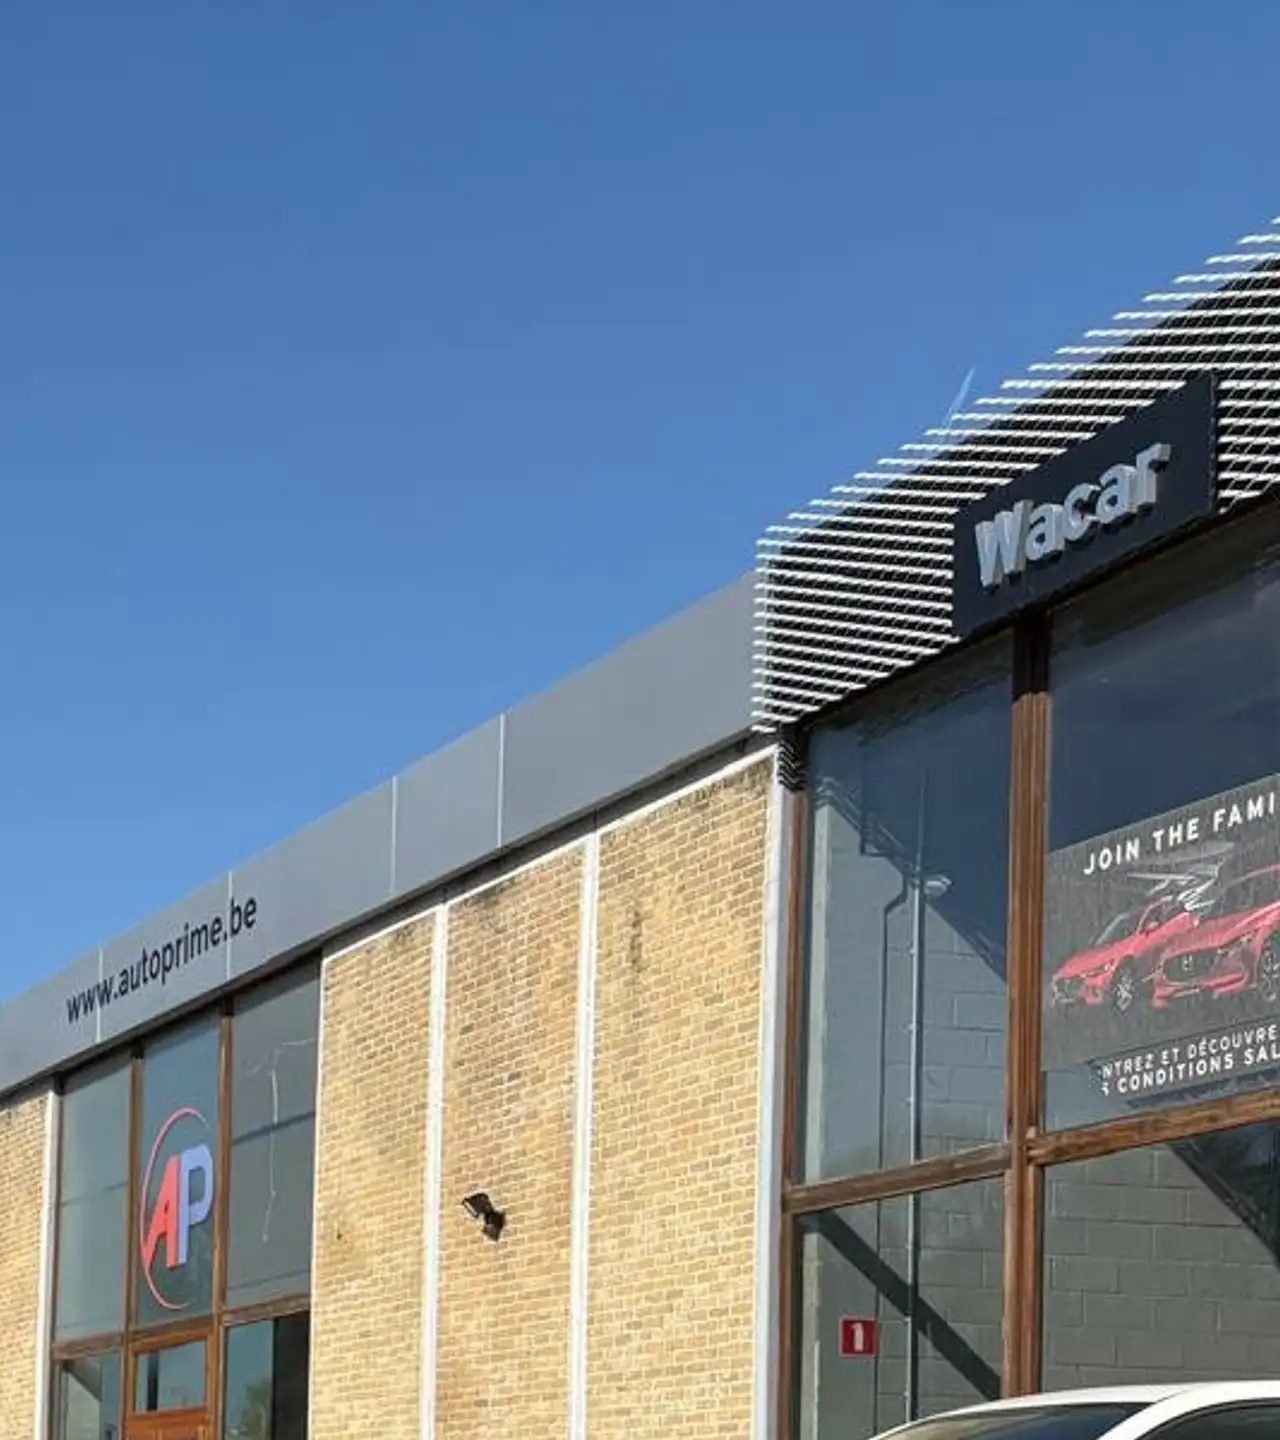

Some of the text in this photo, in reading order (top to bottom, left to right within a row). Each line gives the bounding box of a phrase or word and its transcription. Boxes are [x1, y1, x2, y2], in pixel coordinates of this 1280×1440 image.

[975, 443, 1172, 588] Wacar
[1083, 792, 1275, 875] JOIN THE FAMI
[66, 897, 257, 1024] www.autoprime.be
[1098, 1053, 1155, 1079] NTREZ
[1161, 1048, 1180, 1065] ET
[1117, 1053, 1233, 1093] CONDITIONS
[145, 1143, 214, 1269] AP
[851, 1322, 864, 1352] 1
